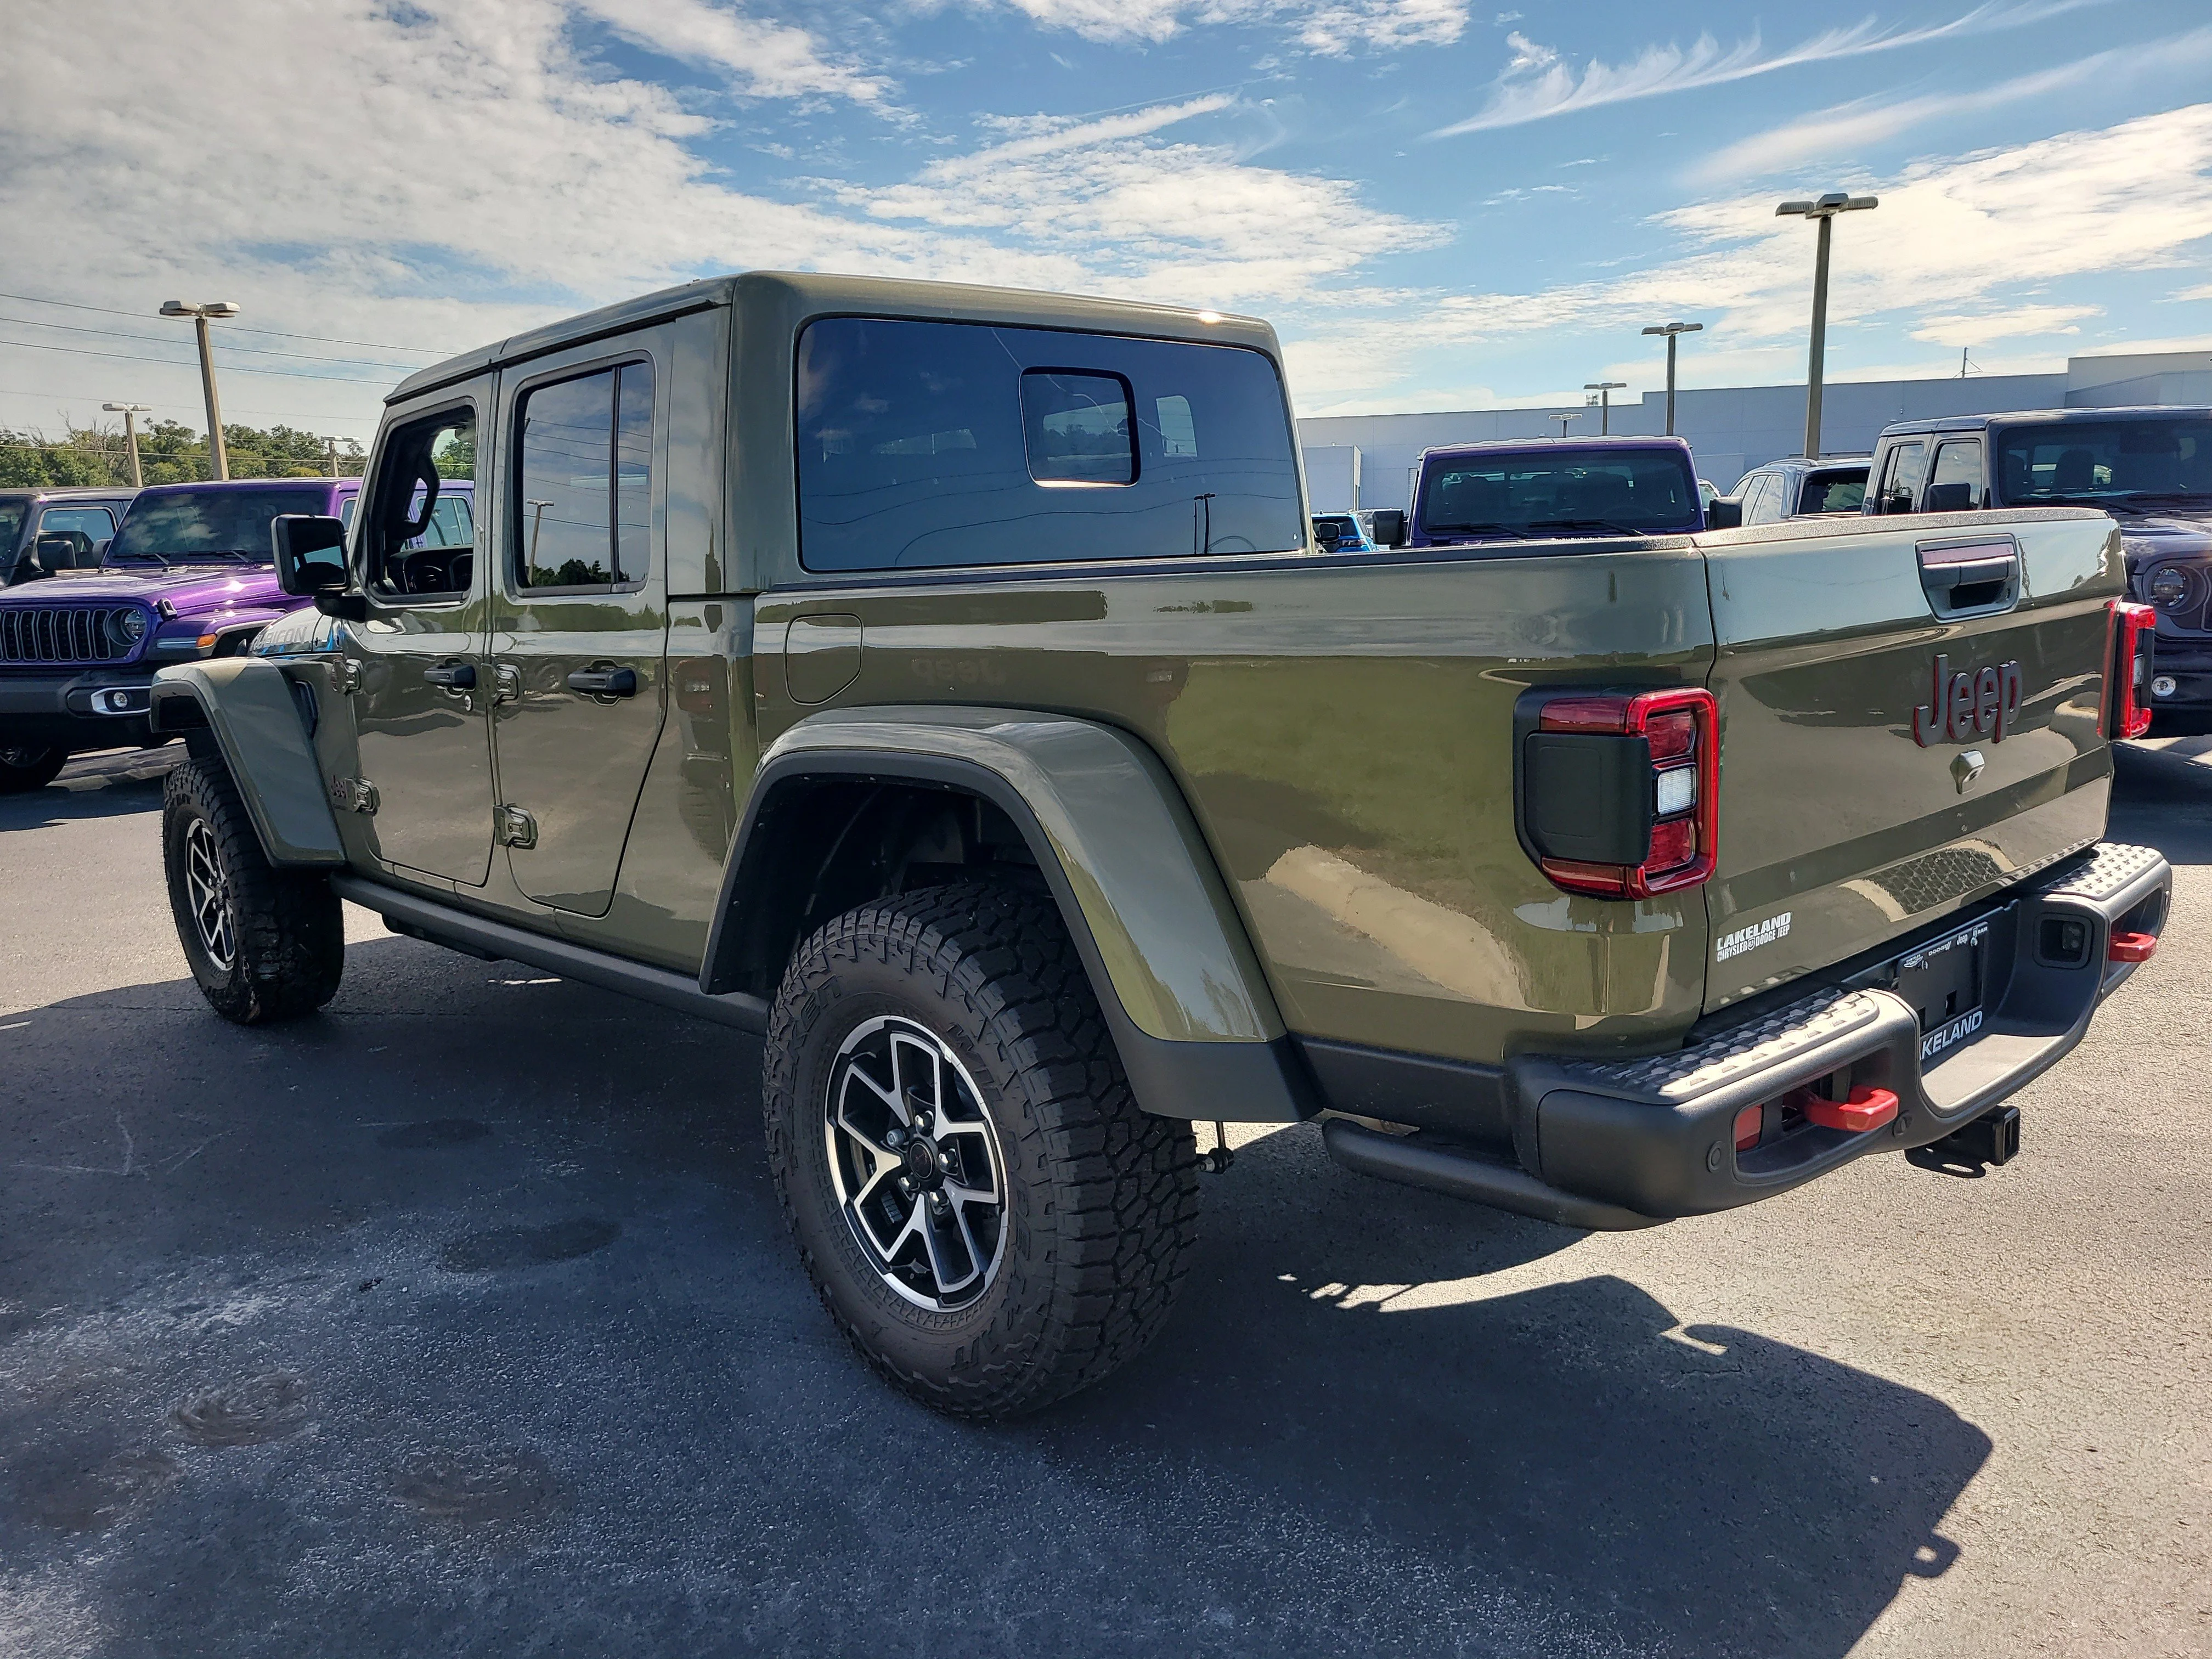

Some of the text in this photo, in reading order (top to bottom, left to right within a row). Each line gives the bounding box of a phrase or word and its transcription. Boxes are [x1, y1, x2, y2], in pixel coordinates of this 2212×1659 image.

[250, 627, 307, 651] RUBICON
[1914, 653, 2022, 748] Jeep
[331, 774, 347, 799] Jeep
[1717, 912, 1791, 951] LAKELAND
[1717, 924, 1790, 962] CHRYSLER DODGE JEEP
[1957, 934, 1968, 945] Jeep
[1920, 1010, 1983, 1060] KELAND
